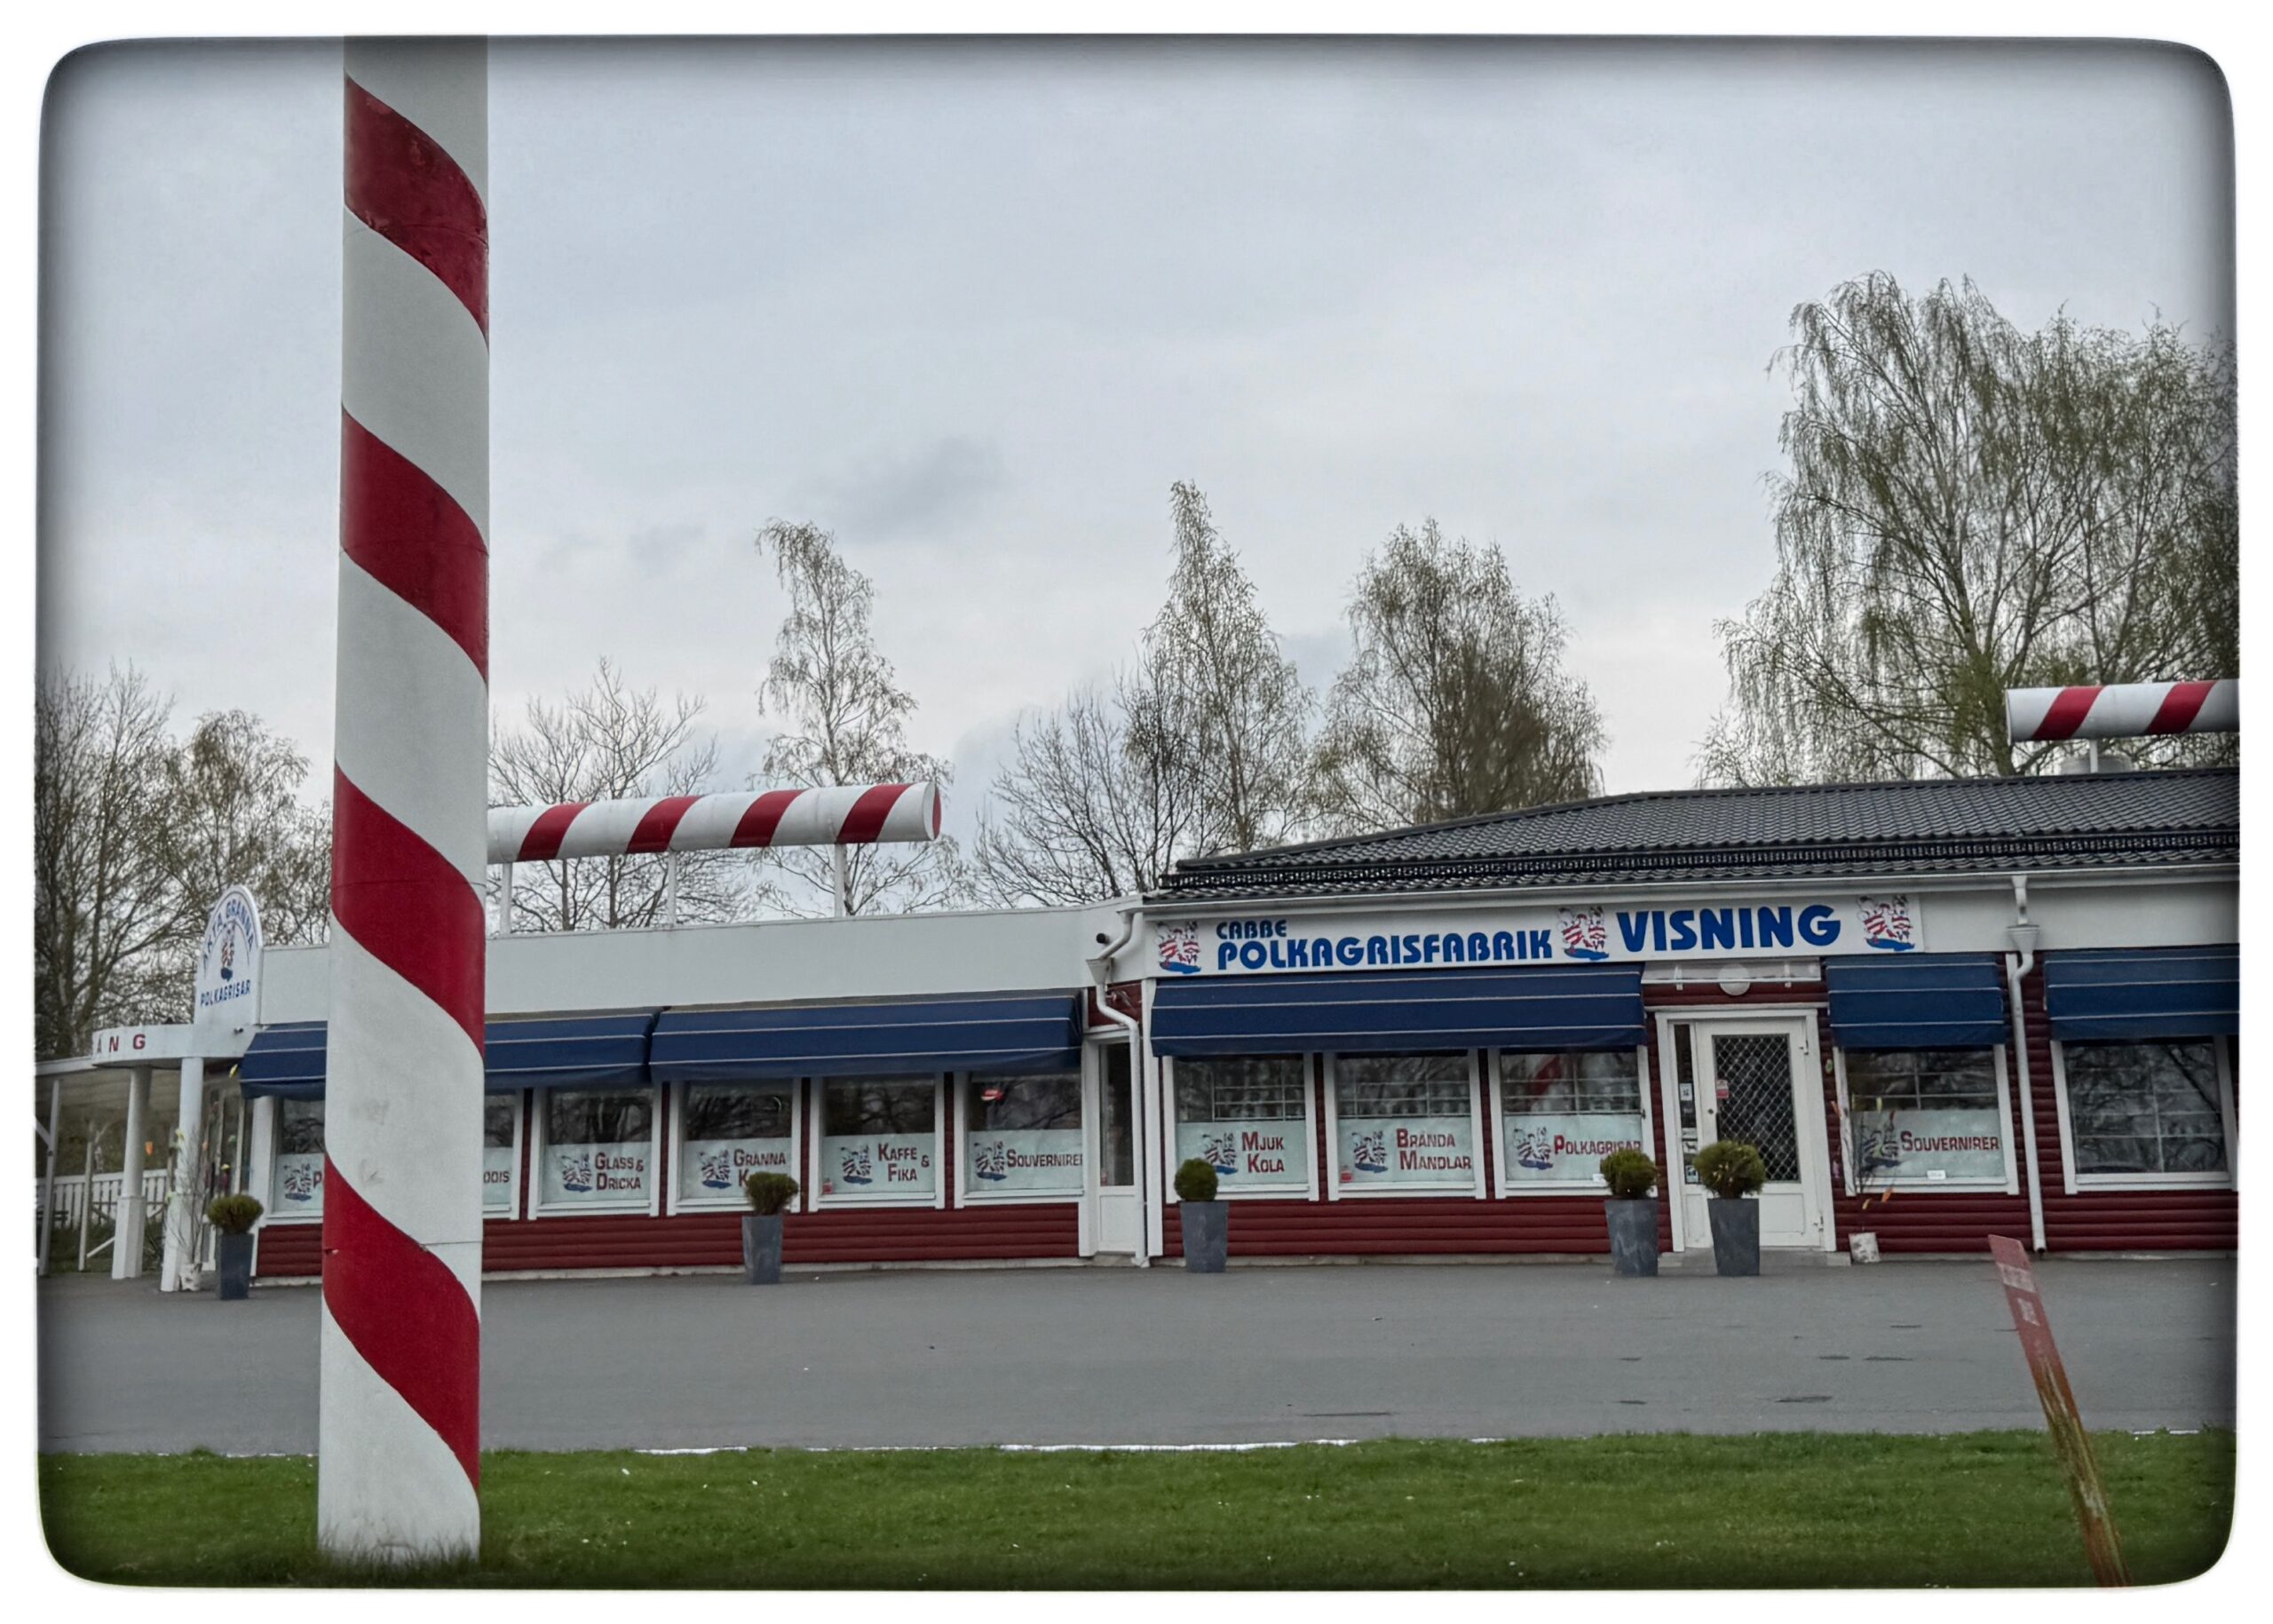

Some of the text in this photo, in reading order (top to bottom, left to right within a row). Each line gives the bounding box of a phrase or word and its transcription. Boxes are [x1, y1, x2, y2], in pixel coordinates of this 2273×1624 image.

[1216, 920, 1287, 939] CABBE
[1616, 905, 1841, 953] VISNING
[1217, 930, 1552, 970] POLKAGRISFABRIK
